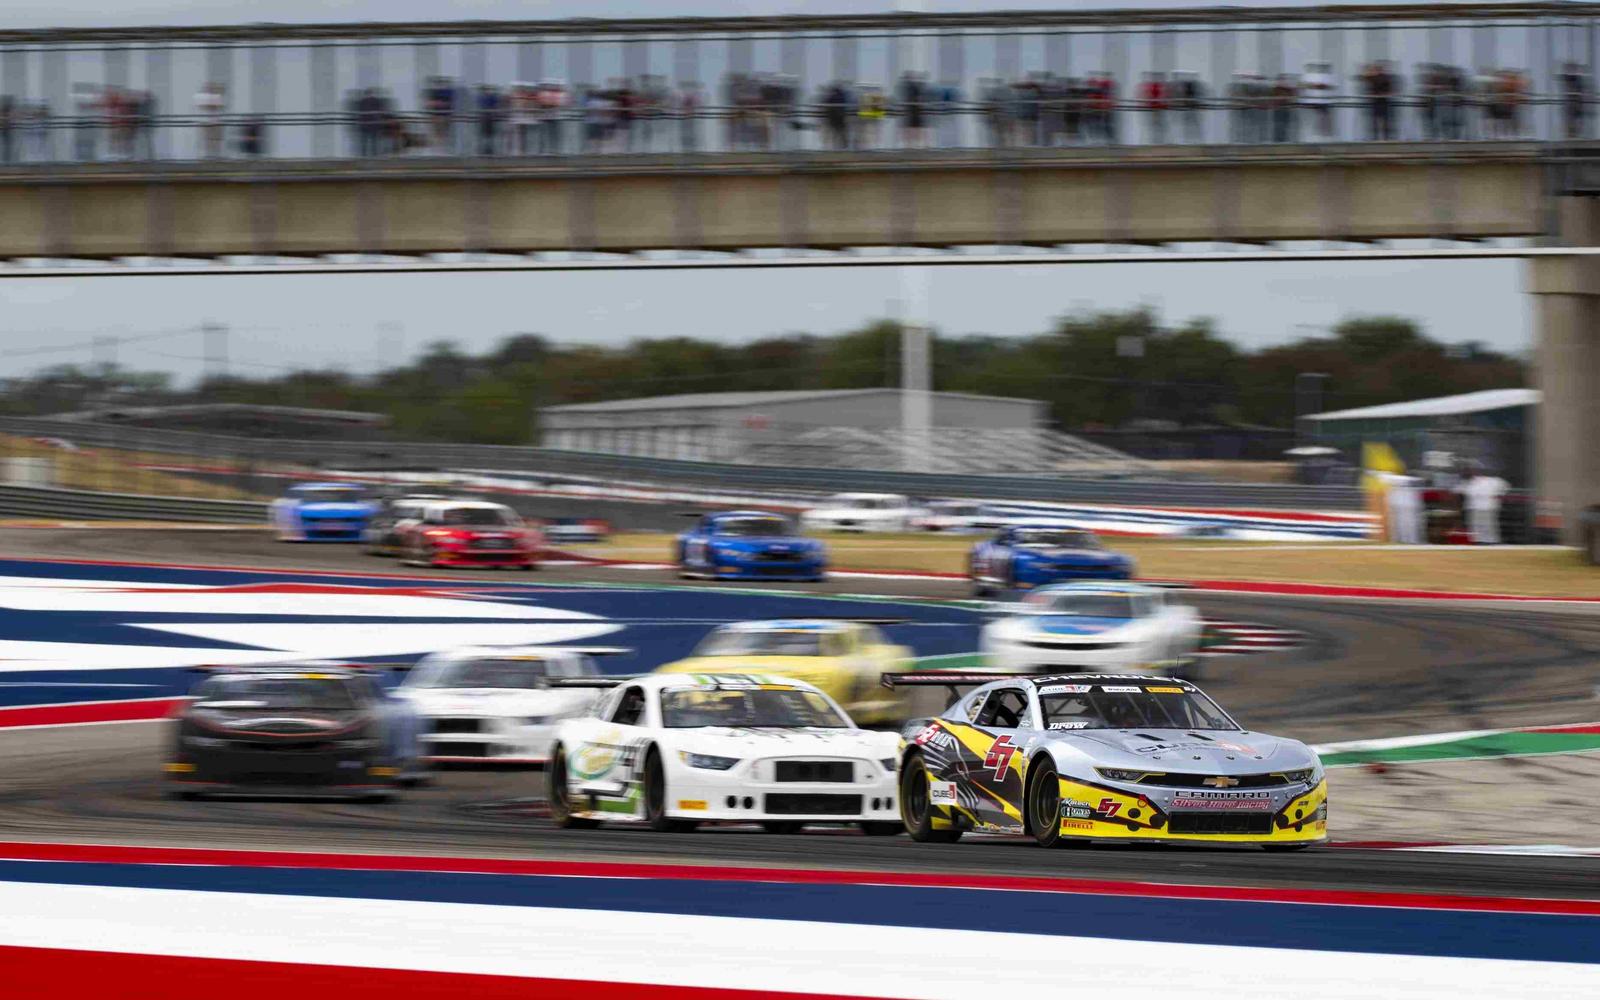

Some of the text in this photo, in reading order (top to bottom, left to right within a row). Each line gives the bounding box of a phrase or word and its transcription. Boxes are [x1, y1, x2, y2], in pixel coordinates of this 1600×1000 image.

[983, 733, 1018, 782] 57
[1175, 791, 1271, 799] CAMARO
[1096, 797, 1123, 817] 57
[1236, 800, 1269, 809] Racing
